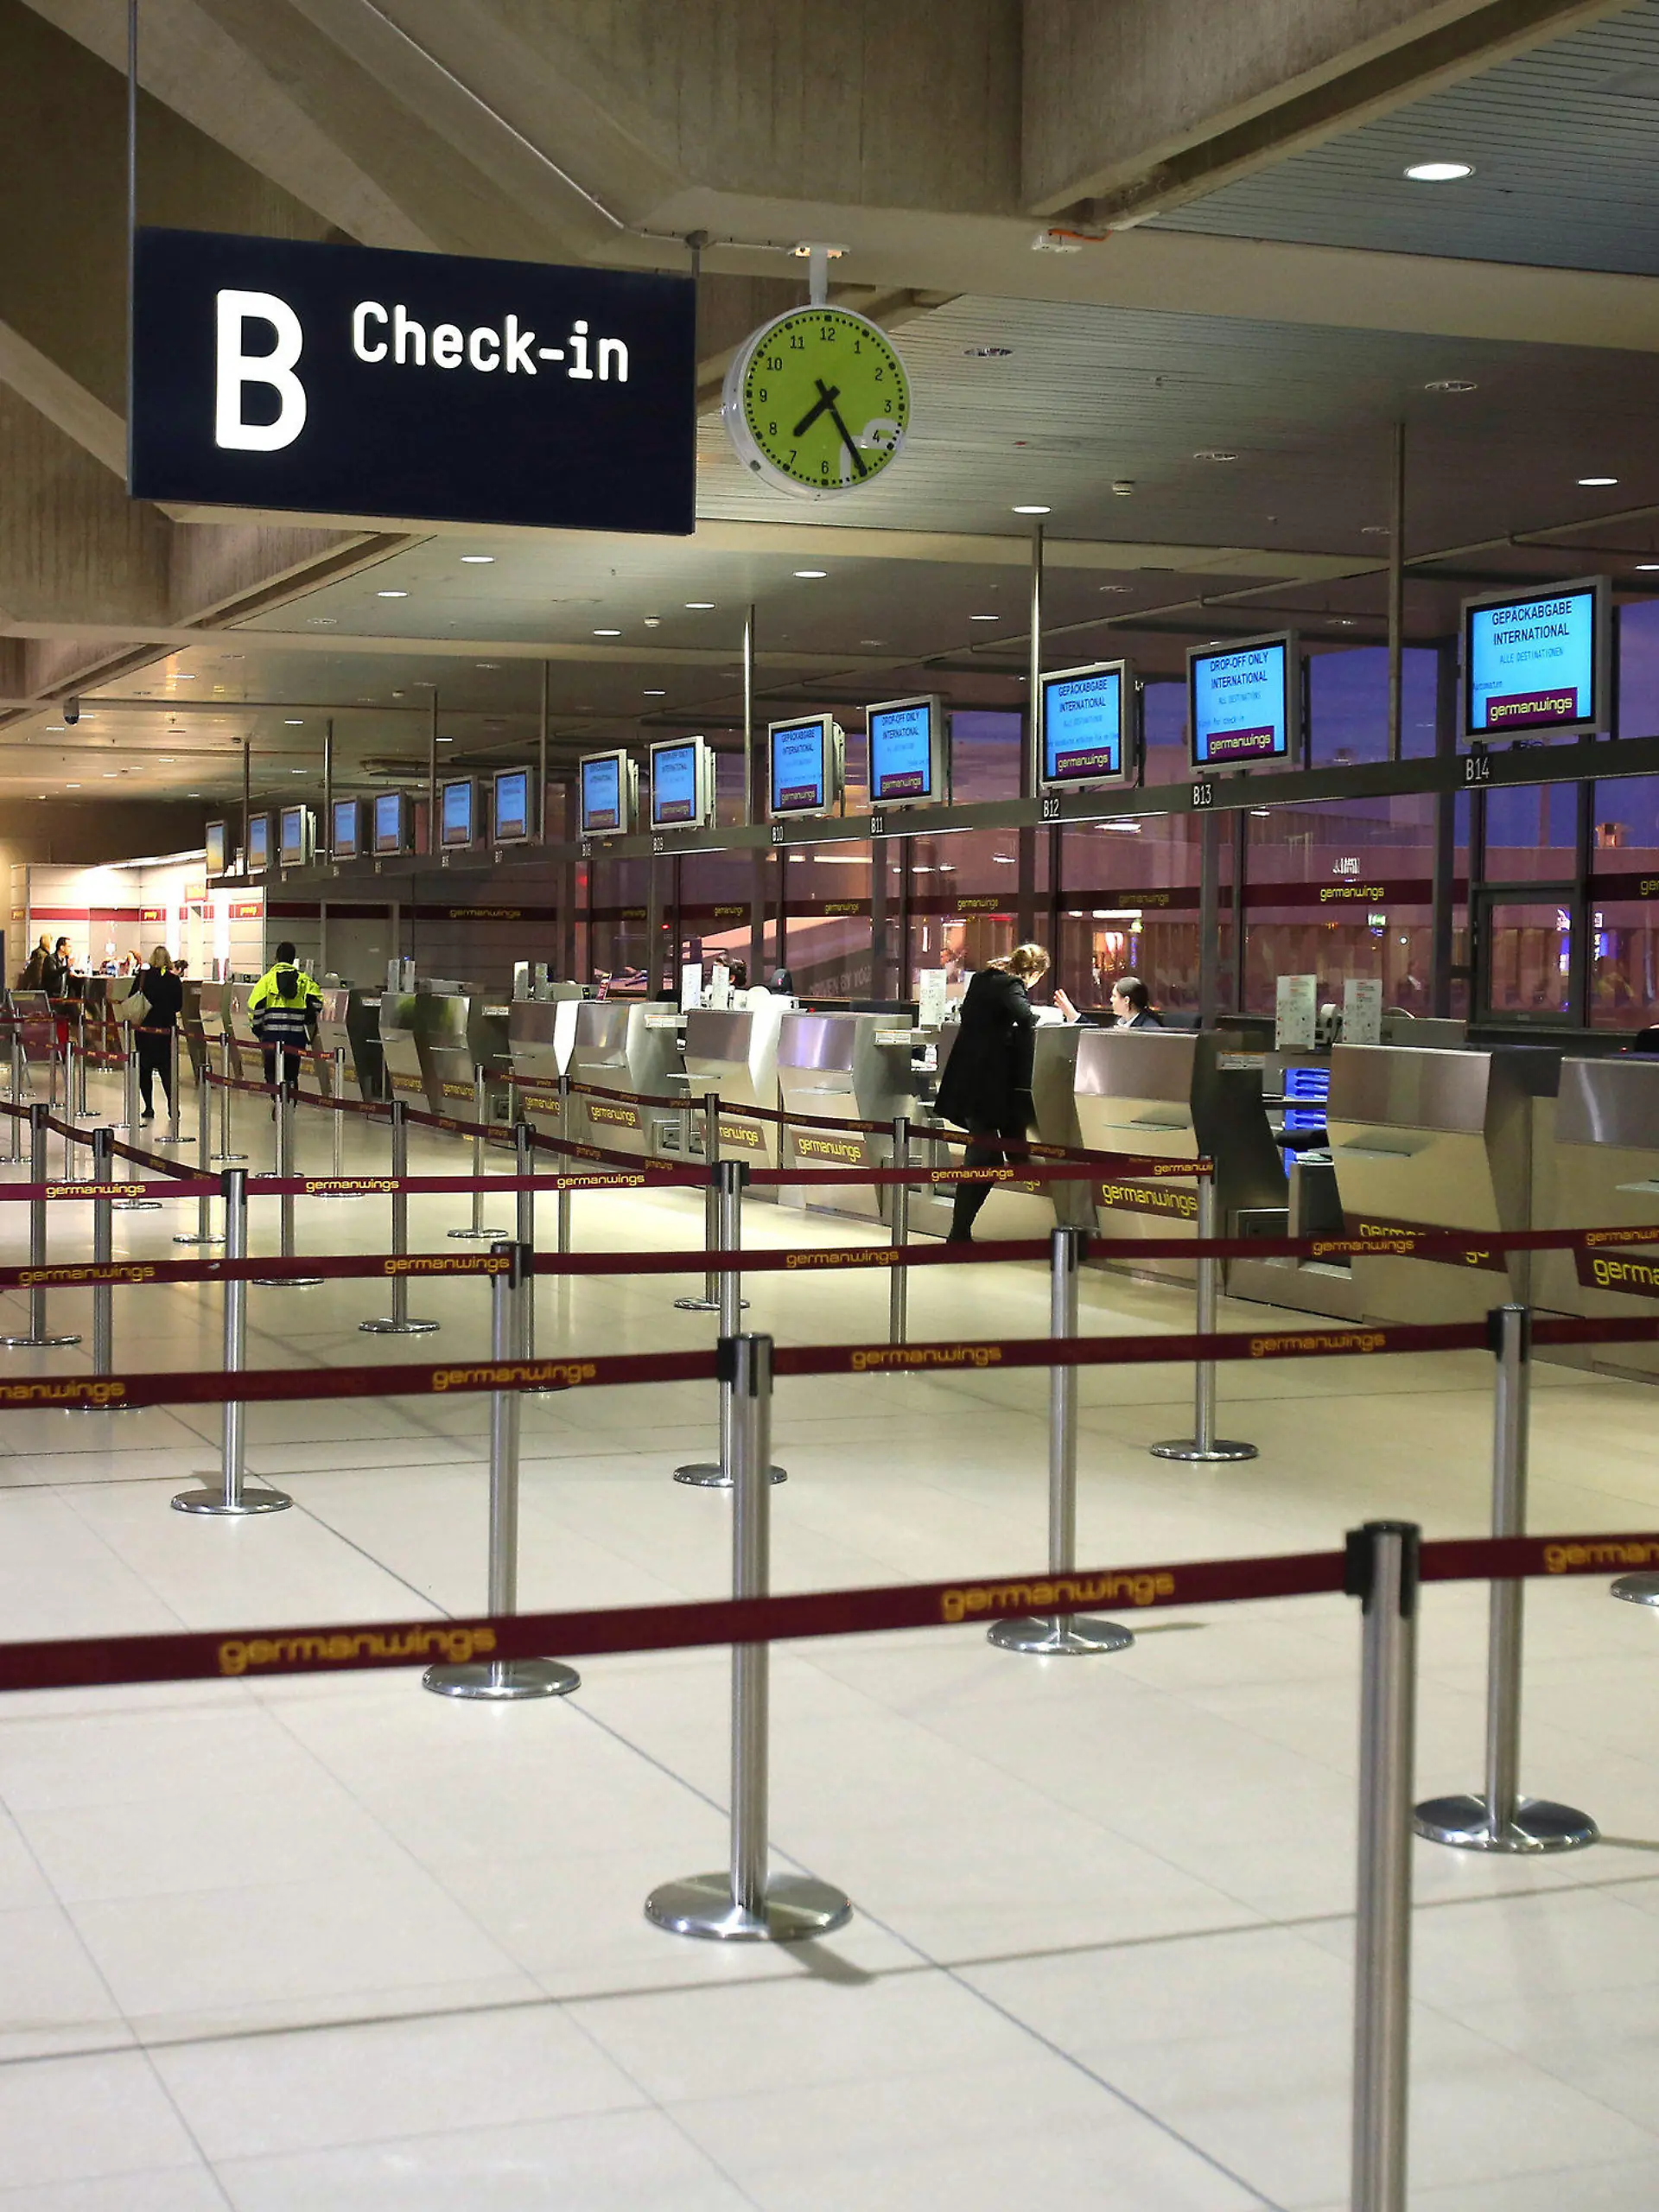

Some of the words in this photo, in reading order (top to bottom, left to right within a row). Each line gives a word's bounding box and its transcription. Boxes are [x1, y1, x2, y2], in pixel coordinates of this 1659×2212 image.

[353, 300, 631, 384] Check-in
[790, 334, 805, 350] 11
[820, 327, 836, 342] 12
[854, 340, 861, 354] 1
[214, 289, 308, 452] B
[766, 357, 783, 371] 10
[874, 367, 883, 382] 2
[759, 389, 767, 403] 9
[884, 399, 892, 414] 3
[769, 422, 778, 435] 8
[872, 429, 880, 442] 4
[788, 449, 798, 465] 7
[822, 461, 830, 474] 6
[1493, 622, 1570, 646] INTERNATIONAL
[1210, 653, 1247, 672] DROP-OFF
[1249, 652, 1269, 664] ONLY
[1211, 670, 1268, 690] INTERNATIONAL
[1059, 696, 1107, 714] INTERNATIONAL
[1490, 696, 1573, 721] germanwings
[1210, 733, 1271, 754] germanwings
[1058, 753, 1109, 772] germanwings
[1465, 756, 1491, 781] B14
[1193, 785, 1211, 805] B13
[1043, 799, 1060, 817] B12
[1319, 885, 1385, 902] germanwings
[449, 908, 522, 918] germanwings
[957, 897, 998, 911] germanwings
[591, 1105, 636, 1126] germanwings
[798, 1137, 861, 1163] germanwings
[556, 1173, 645, 1188] germanwings
[931, 1167, 1014, 1182] germanwings
[46, 1183, 146, 1199] germanwings
[306, 1178, 400, 1193] germanwings
[1101, 1183, 1198, 1217] germanwings
[1313, 1236, 1414, 1255] germanwings
[384, 1254, 511, 1274] germanwings
[785, 1247, 899, 1267] germanwings
[18, 1262, 156, 1287] germanwings
[1250, 1332, 1386, 1357] germanwings
[850, 1345, 1002, 1369] germanwings
[432, 1362, 596, 1389] germanwings
[941, 1571, 1175, 1623] germanwings
[218, 1626, 497, 1676] germanwings
